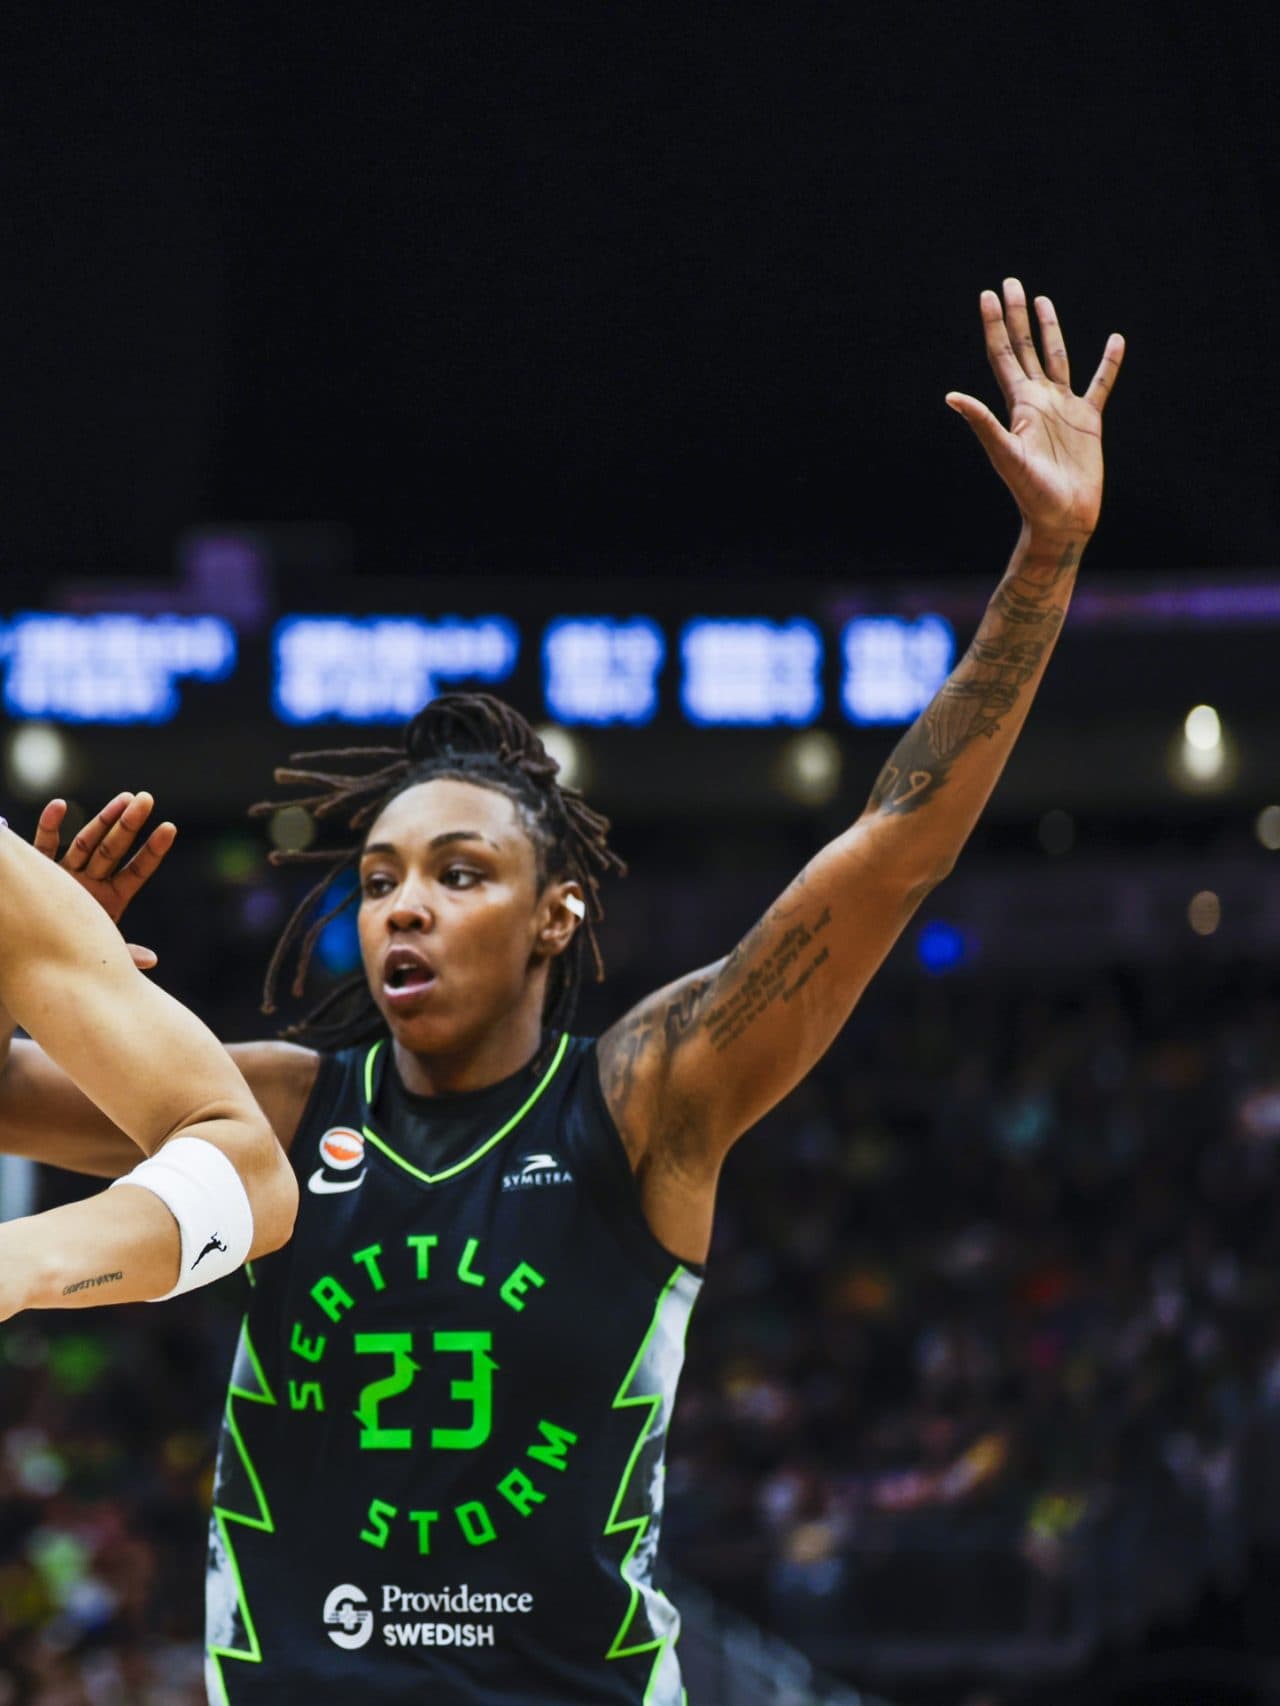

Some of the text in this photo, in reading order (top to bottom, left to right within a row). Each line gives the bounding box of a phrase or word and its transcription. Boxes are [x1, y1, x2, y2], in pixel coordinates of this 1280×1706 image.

[502, 1171, 574, 1188] SYMETRA
[288, 1234, 546, 1412] SEATTLE
[352, 1330, 500, 1449] 23
[359, 1419, 579, 1555] STORM
[381, 1584, 534, 1612] Providence
[383, 1622, 495, 1647] SWEDISH
